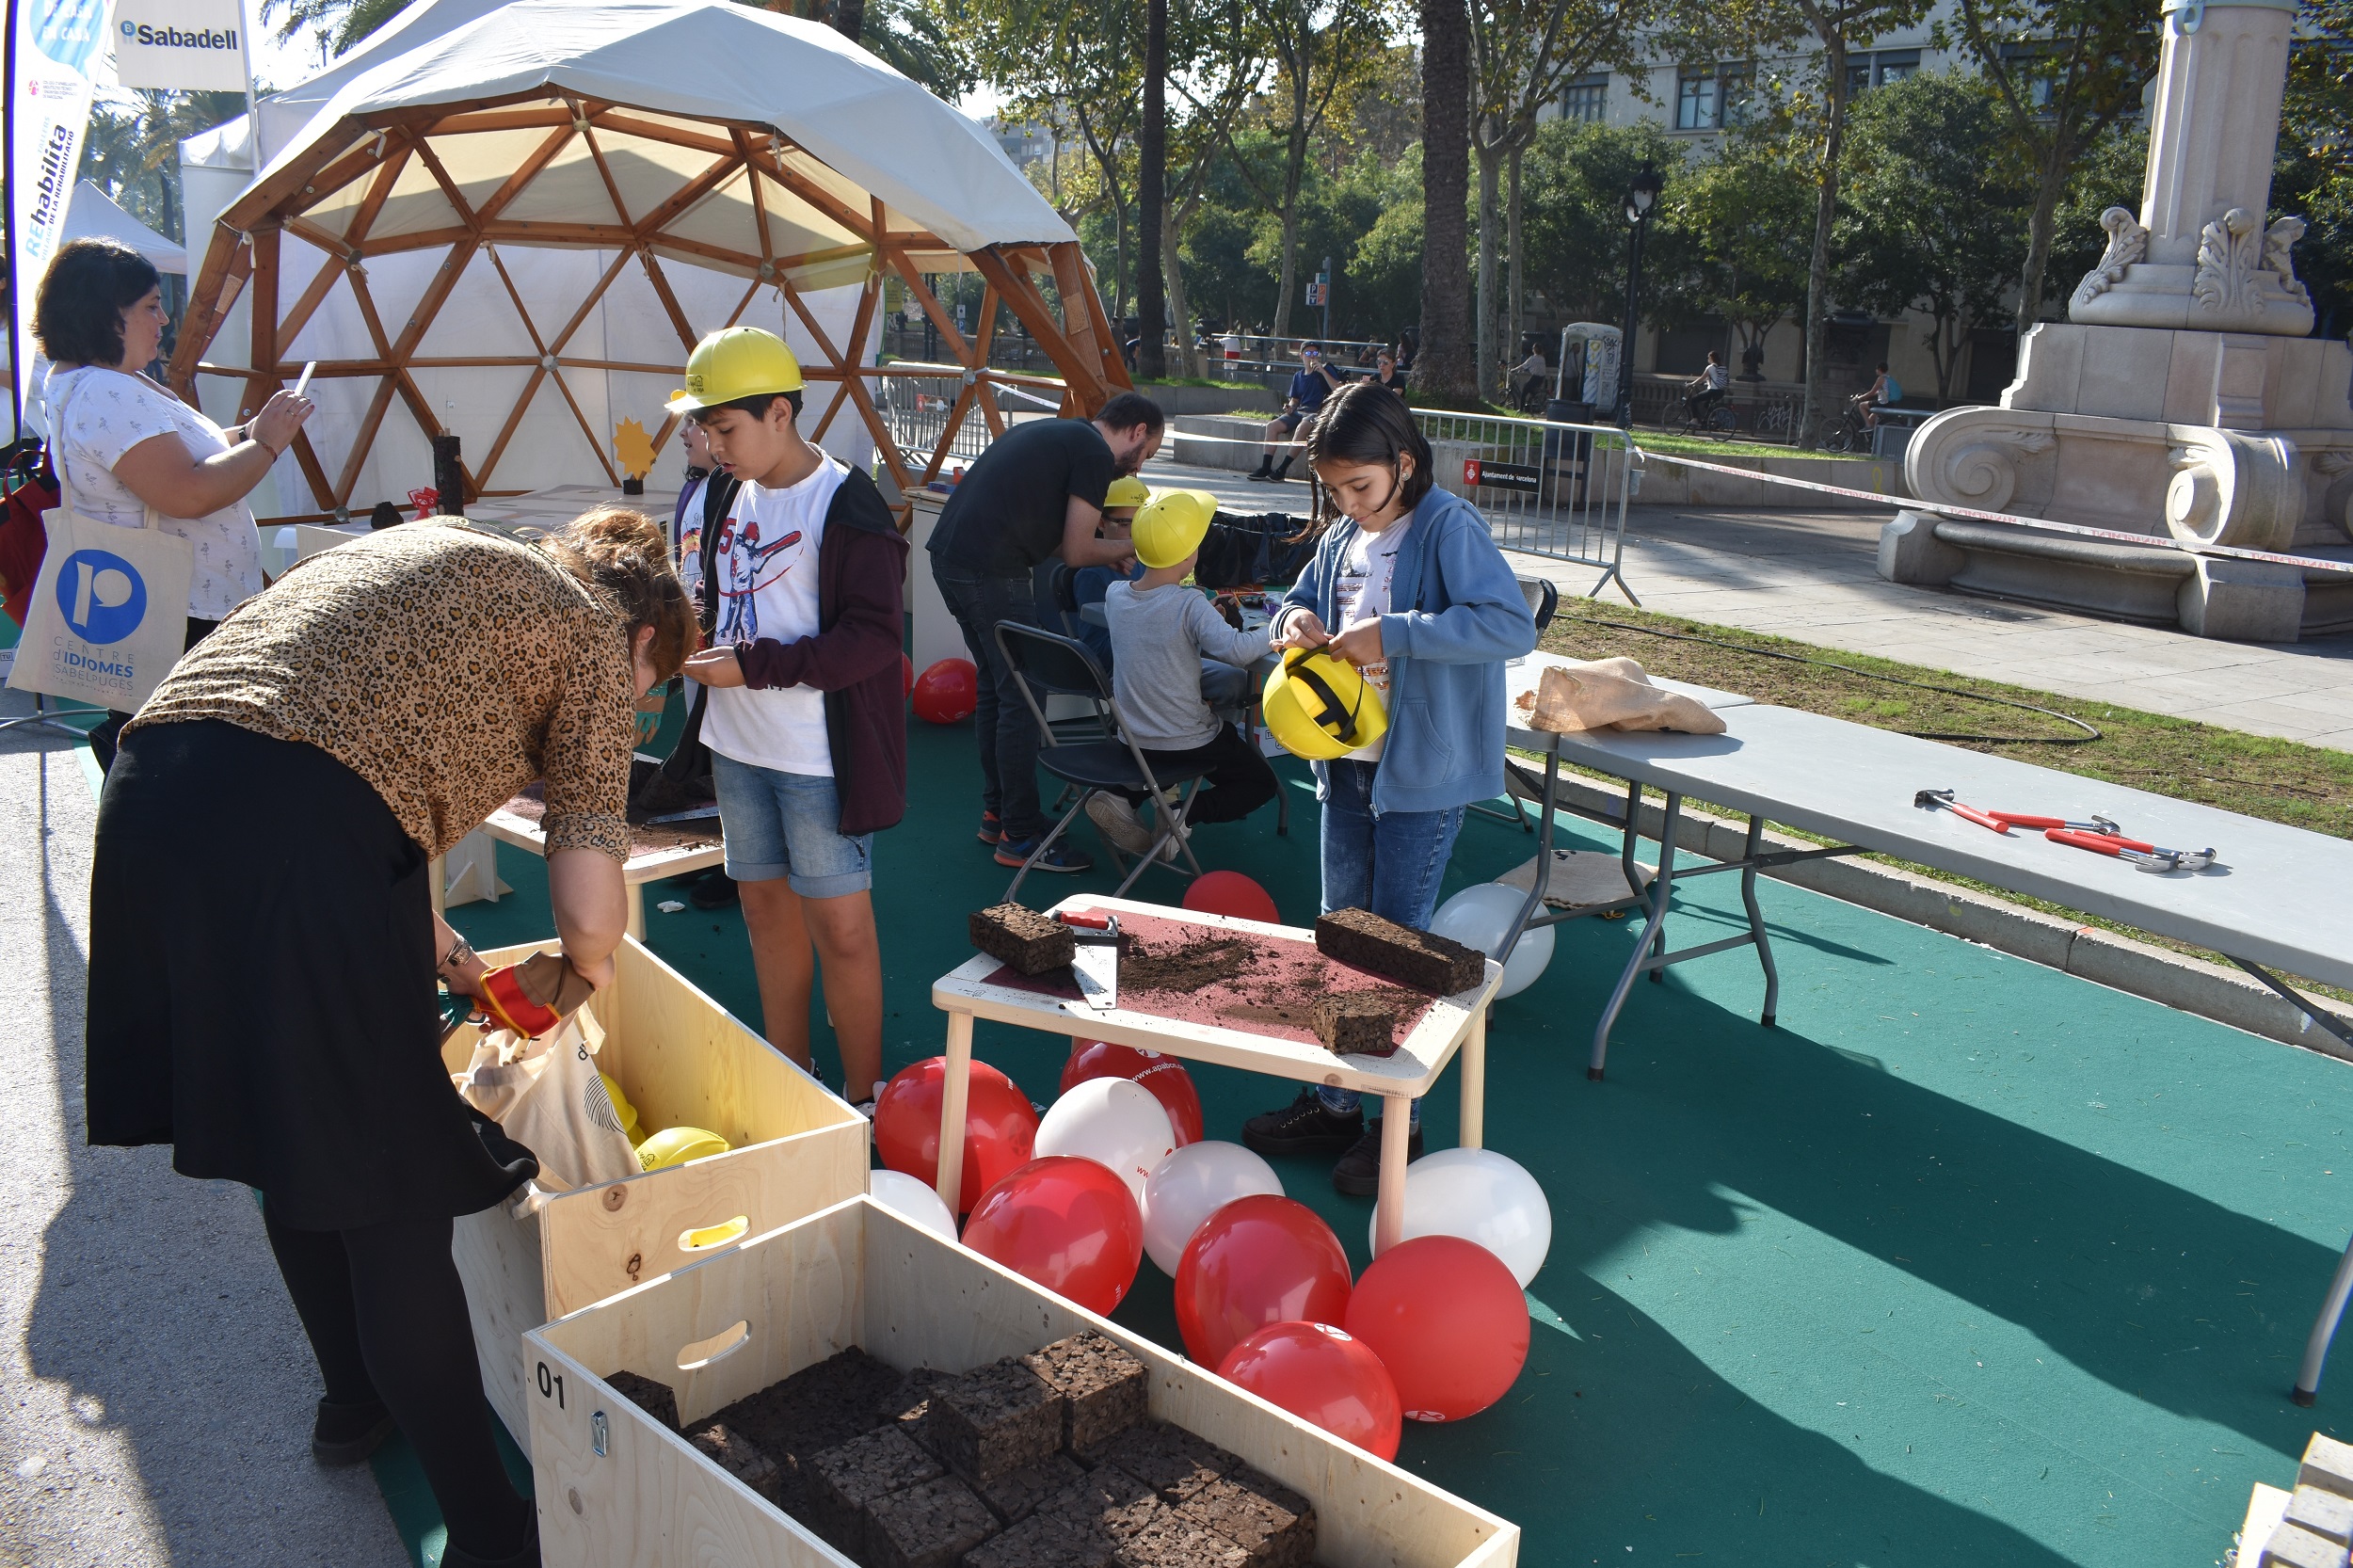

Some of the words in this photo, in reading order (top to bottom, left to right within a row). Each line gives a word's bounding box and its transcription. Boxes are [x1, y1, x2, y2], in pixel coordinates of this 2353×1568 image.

[61, 26, 90, 41] CASA
[137, 24, 238, 50] Sabadell
[38, 116, 51, 153] TALLERS
[25, 124, 67, 257] REhabilita
[49, 213, 56, 225] DE
[52, 200, 59, 212] LA
[41, 226, 53, 261] VILLAGE
[1481, 471, 1509, 480] Ajuntament
[1515, 473, 1537, 484] arcelona
[53, 649, 134, 678] d'IDIOMES
[54, 635, 135, 664] CENTRE
[536, 1361, 565, 1410] 01
